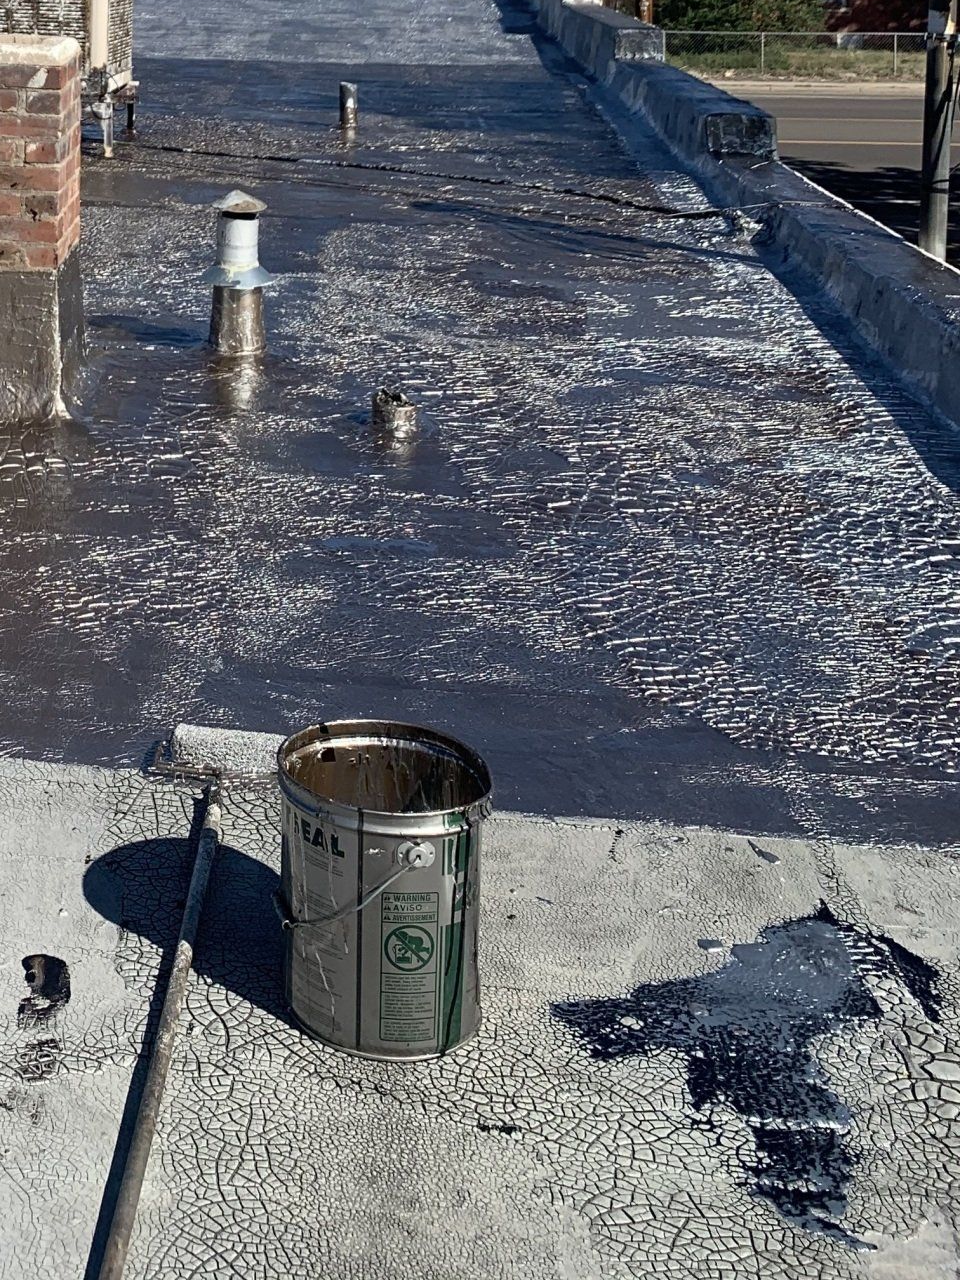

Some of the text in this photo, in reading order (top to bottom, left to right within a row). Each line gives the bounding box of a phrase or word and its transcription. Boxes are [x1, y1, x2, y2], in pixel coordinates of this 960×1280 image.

[393, 894, 431, 902] WARNING
[393, 904, 422, 912] AVISO
[392, 913, 436, 922] AVERTISSEMENT
